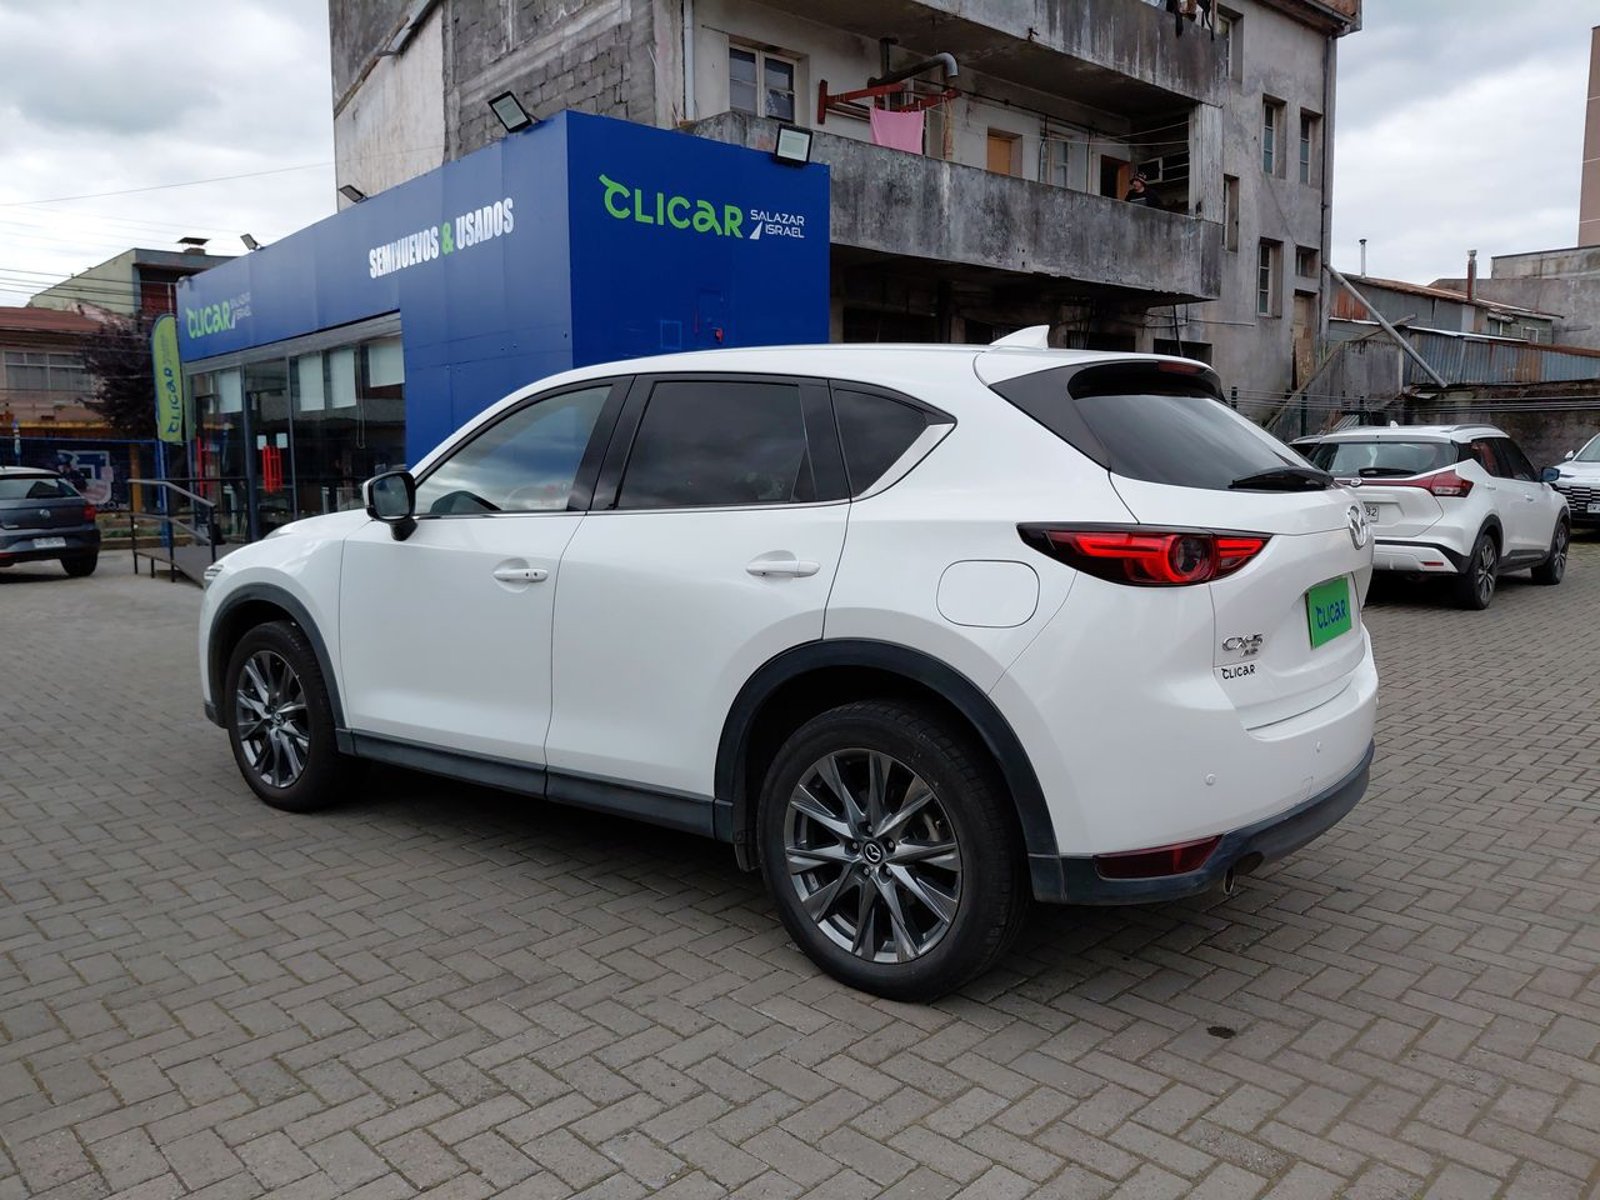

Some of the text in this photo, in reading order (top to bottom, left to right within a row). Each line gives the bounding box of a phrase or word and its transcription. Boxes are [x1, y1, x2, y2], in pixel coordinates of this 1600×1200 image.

[750, 210, 804, 226] SALAZAR
[369, 197, 514, 279] SEMINUEVOS & USADOS
[765, 224, 805, 239] ISRAEL
[1222, 634, 1263, 651] CX-5
